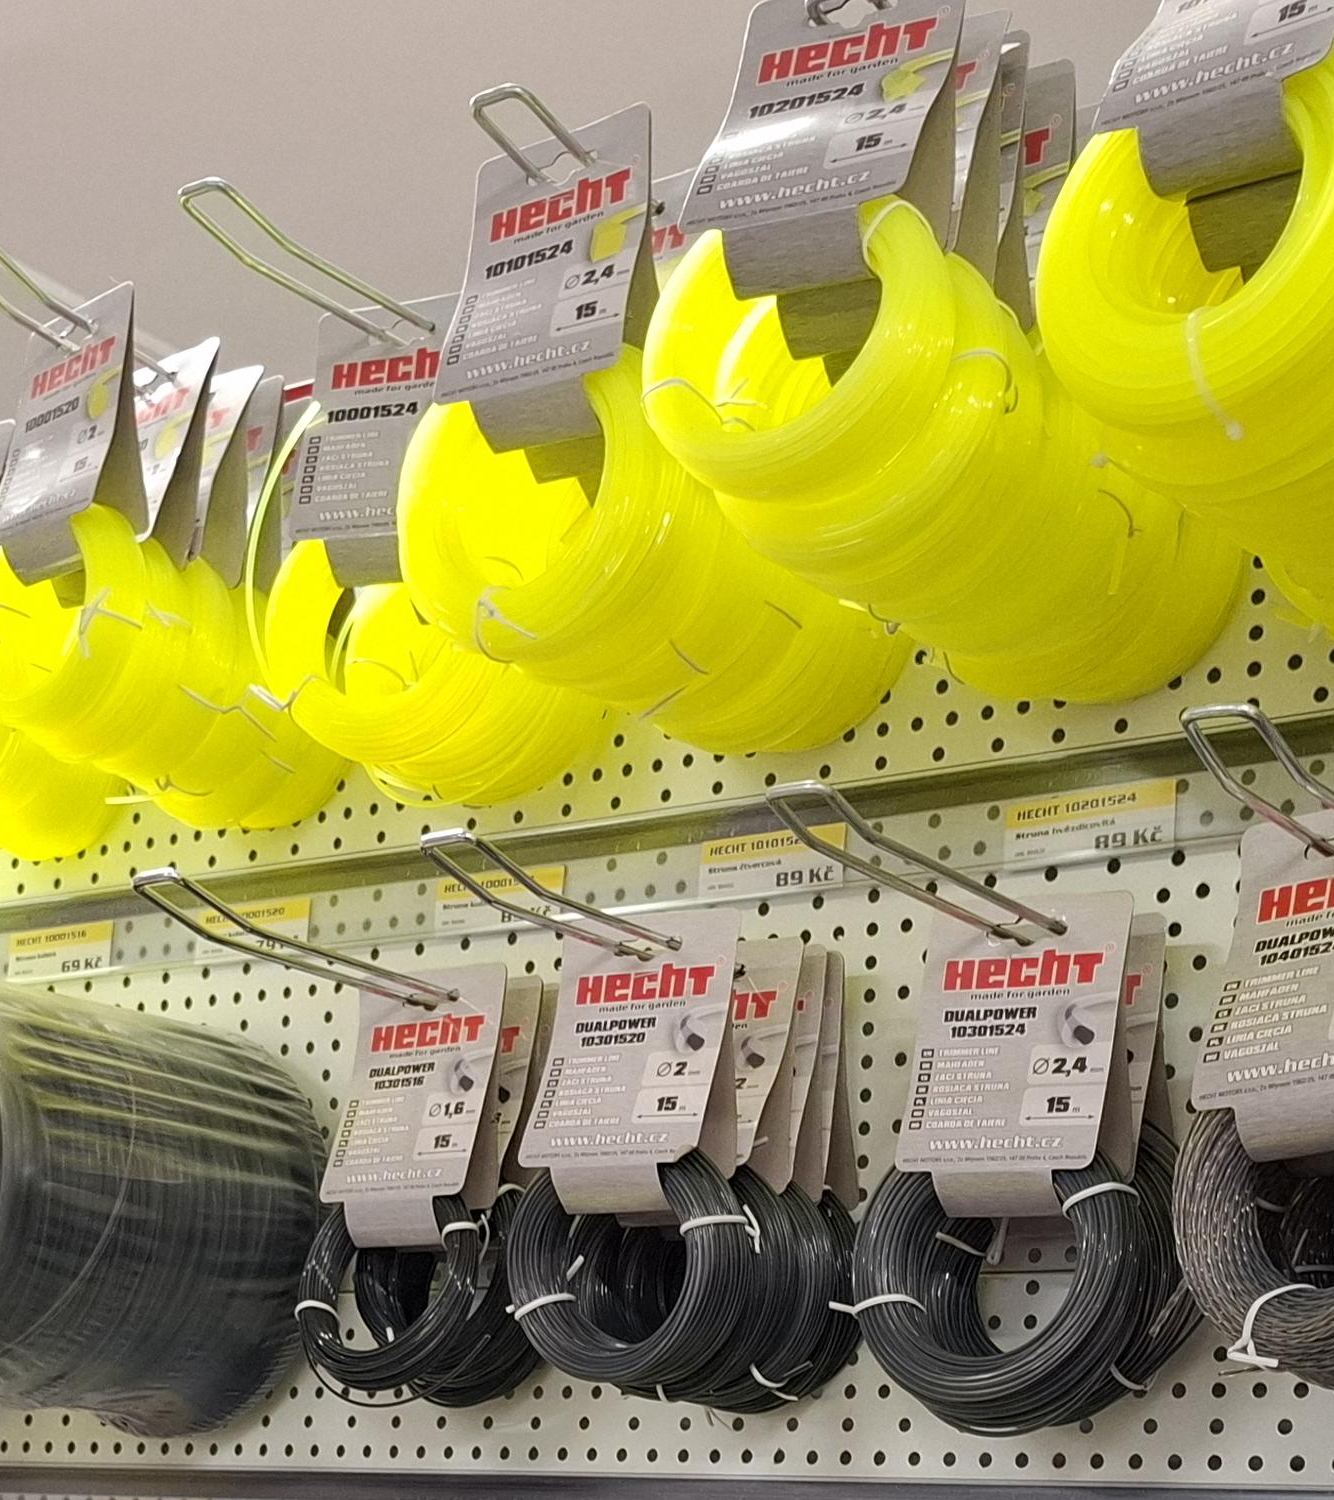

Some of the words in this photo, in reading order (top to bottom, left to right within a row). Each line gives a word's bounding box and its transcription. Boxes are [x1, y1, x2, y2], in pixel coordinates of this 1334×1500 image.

[1134, 41, 1295, 105] www.hecht.cz
[748, 82, 865, 120] 10201524
[485, 240, 573, 279] 10101524
[327, 402, 418, 423] 10001524
[943, 1006, 1037, 1023] DUALPOWER
[575, 1016, 657, 1034] DUALPOWER
[950, 1023, 1026, 1039] 10301524
[580, 1032, 646, 1048] 10301520
[369, 1062, 435, 1079] DUALPOWER
[1051, 1057, 1088, 1077] 2,4
[374, 1076, 425, 1091] 10301516
[928, 1135, 1062, 1151] www.hecht.cz
